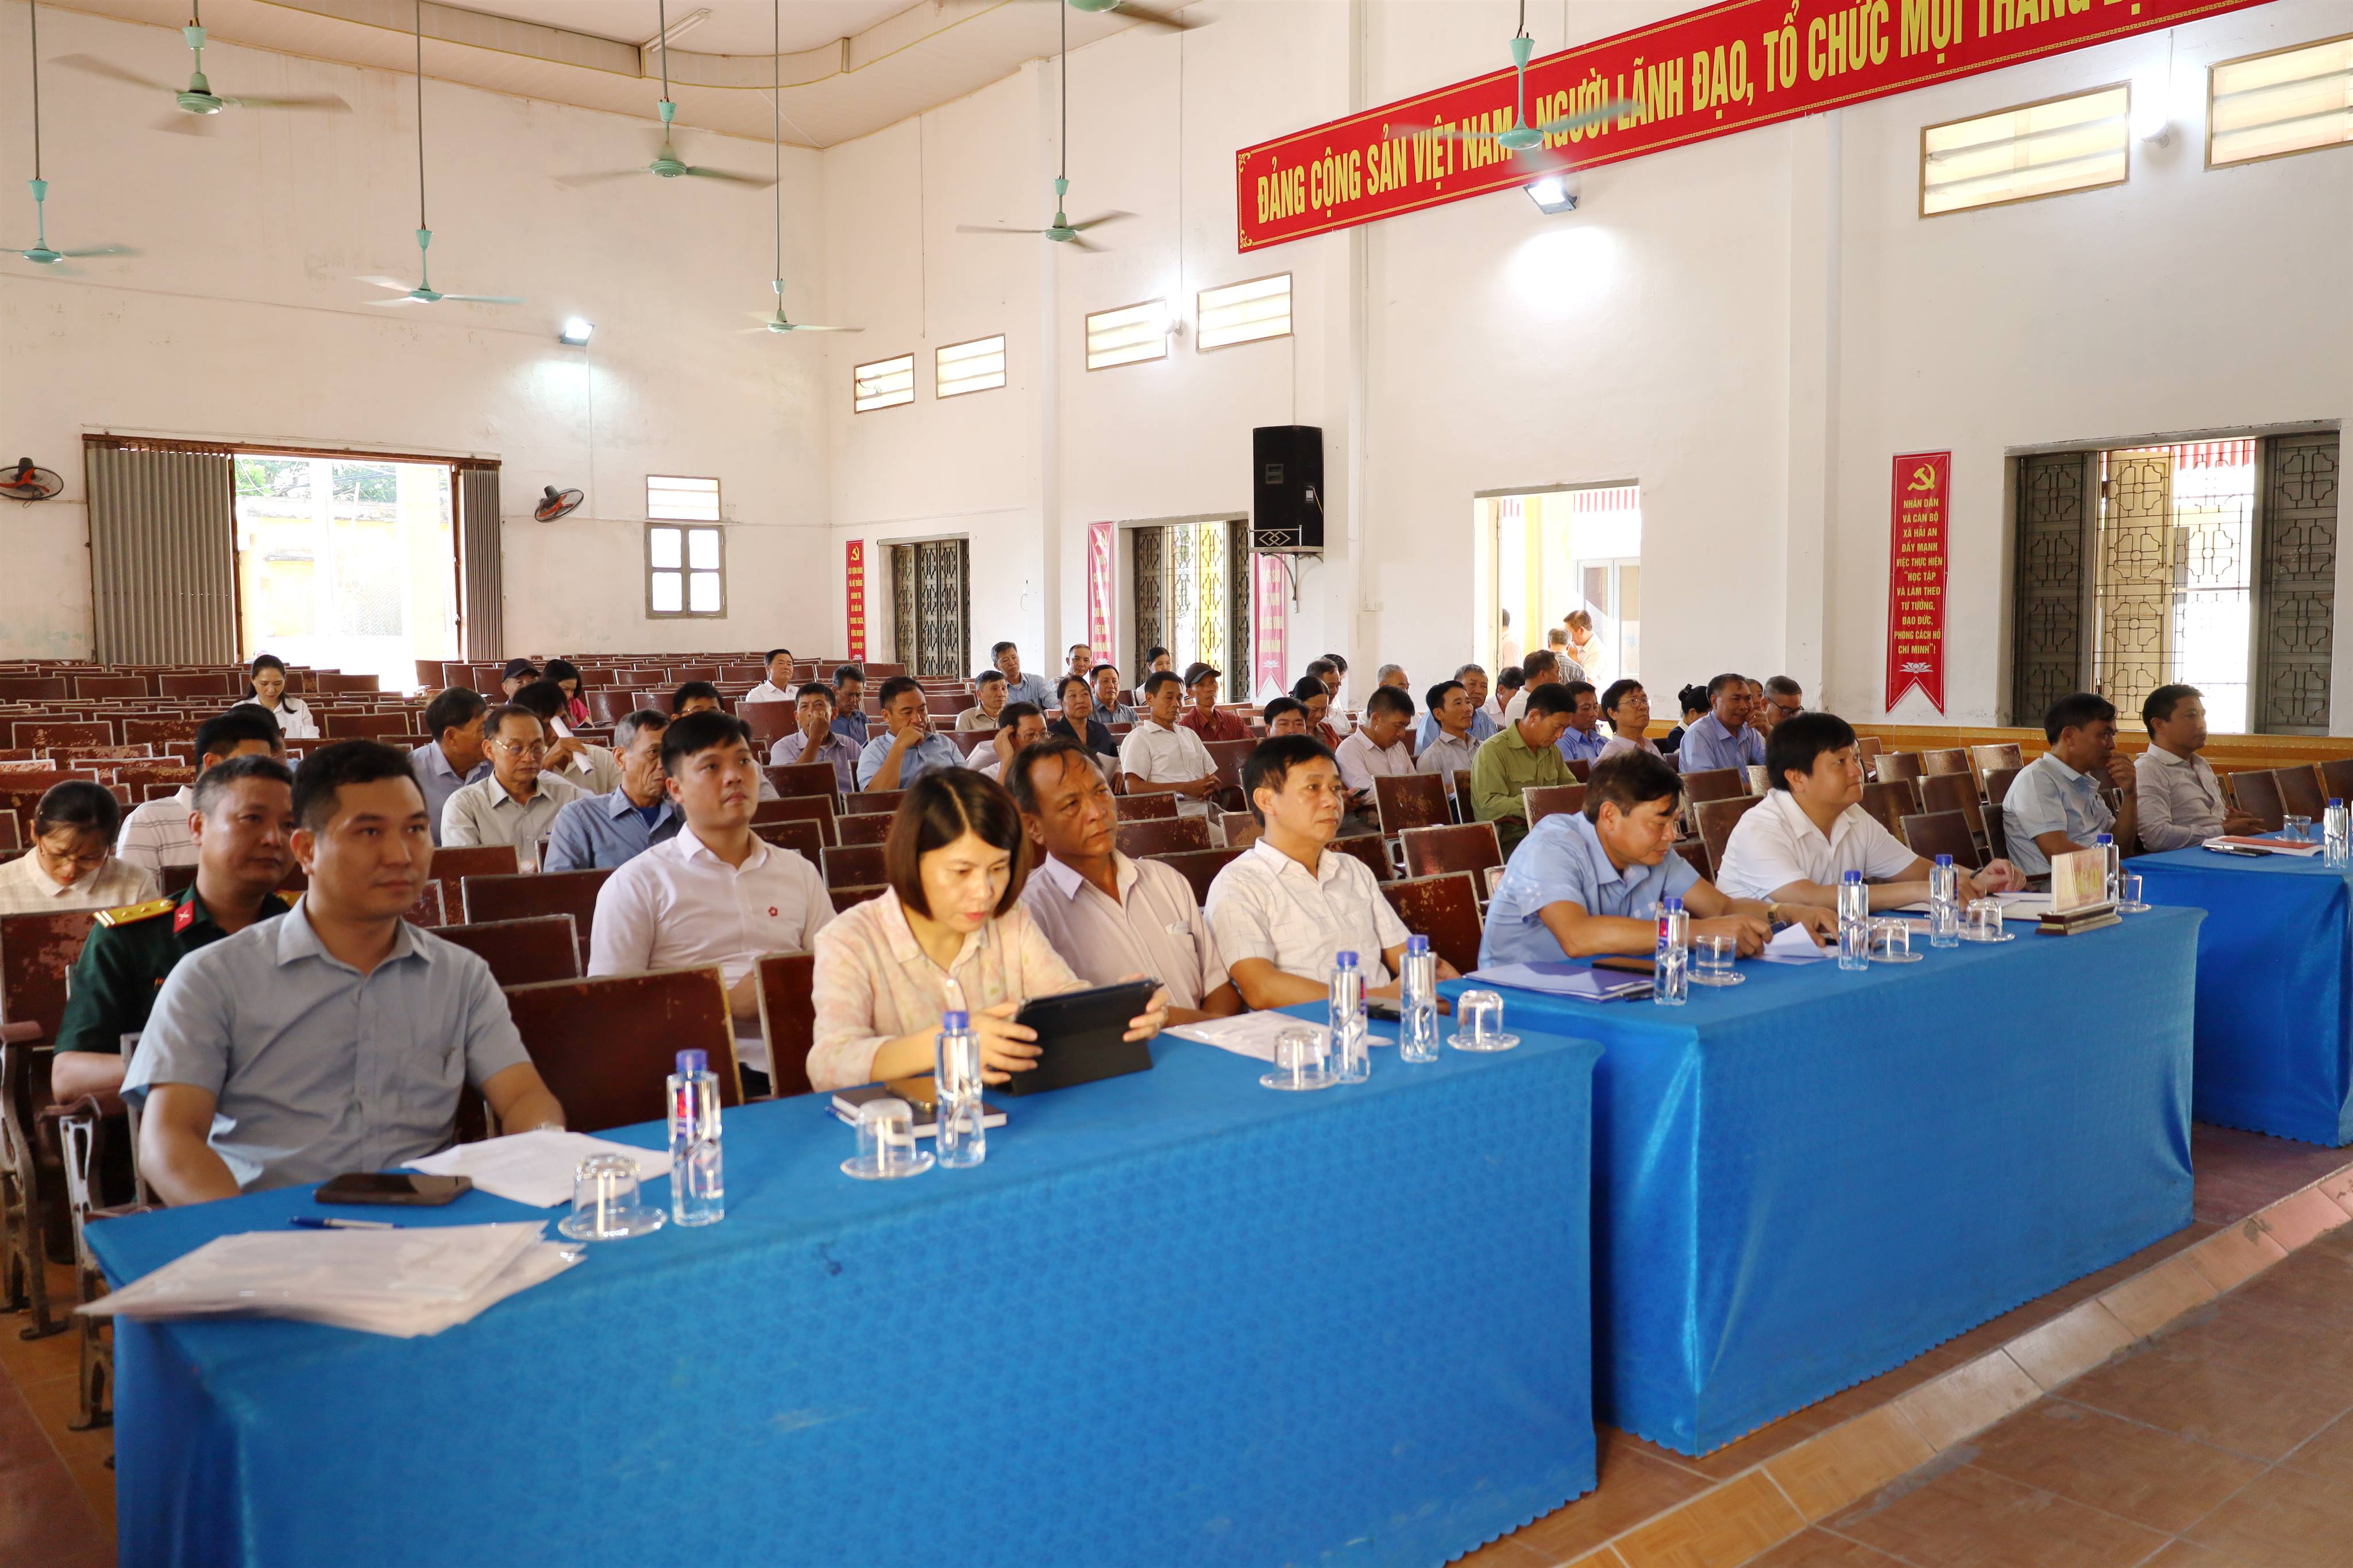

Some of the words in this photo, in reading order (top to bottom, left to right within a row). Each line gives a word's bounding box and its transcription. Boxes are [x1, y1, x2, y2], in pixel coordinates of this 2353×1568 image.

[1257, 156, 1305, 224] ĐẢNG
[1311, 146, 1361, 218] CỘNG
[1367, 123, 1407, 196] SẢN
[1413, 114, 1456, 191] VIỆT
[1463, 106, 1513, 171] NAM
[1536, 68, 1608, 152] NGƯỜI
[1617, 56, 1683, 131] LÃNH
[1692, 40, 1754, 120] ĐẠO,
[1763, 0, 1800, 92] TỔ
[1808, 0, 1889, 81] CHỨC
[1900, 0, 1962, 64] MỌI
[1903, 497, 1922, 509] NHÂN
[1924, 497, 1939, 508] DÂN
[1903, 512, 1911, 523] VÀ
[1929, 511, 1939, 524] BỘ
[1903, 527, 1912, 538] XÃ
[1927, 527, 1937, 537] AN
[1917, 542, 1938, 554] MẠNH
[1896, 557, 1910, 569] VIỆC
[1928, 555, 1942, 568] HIỆN
[1923, 570, 1937, 583] TẬP
[1924, 586, 1941, 596] THEO
[1902, 616, 1916, 627] ĐẠO
[1894, 631, 1914, 640] PHONG
